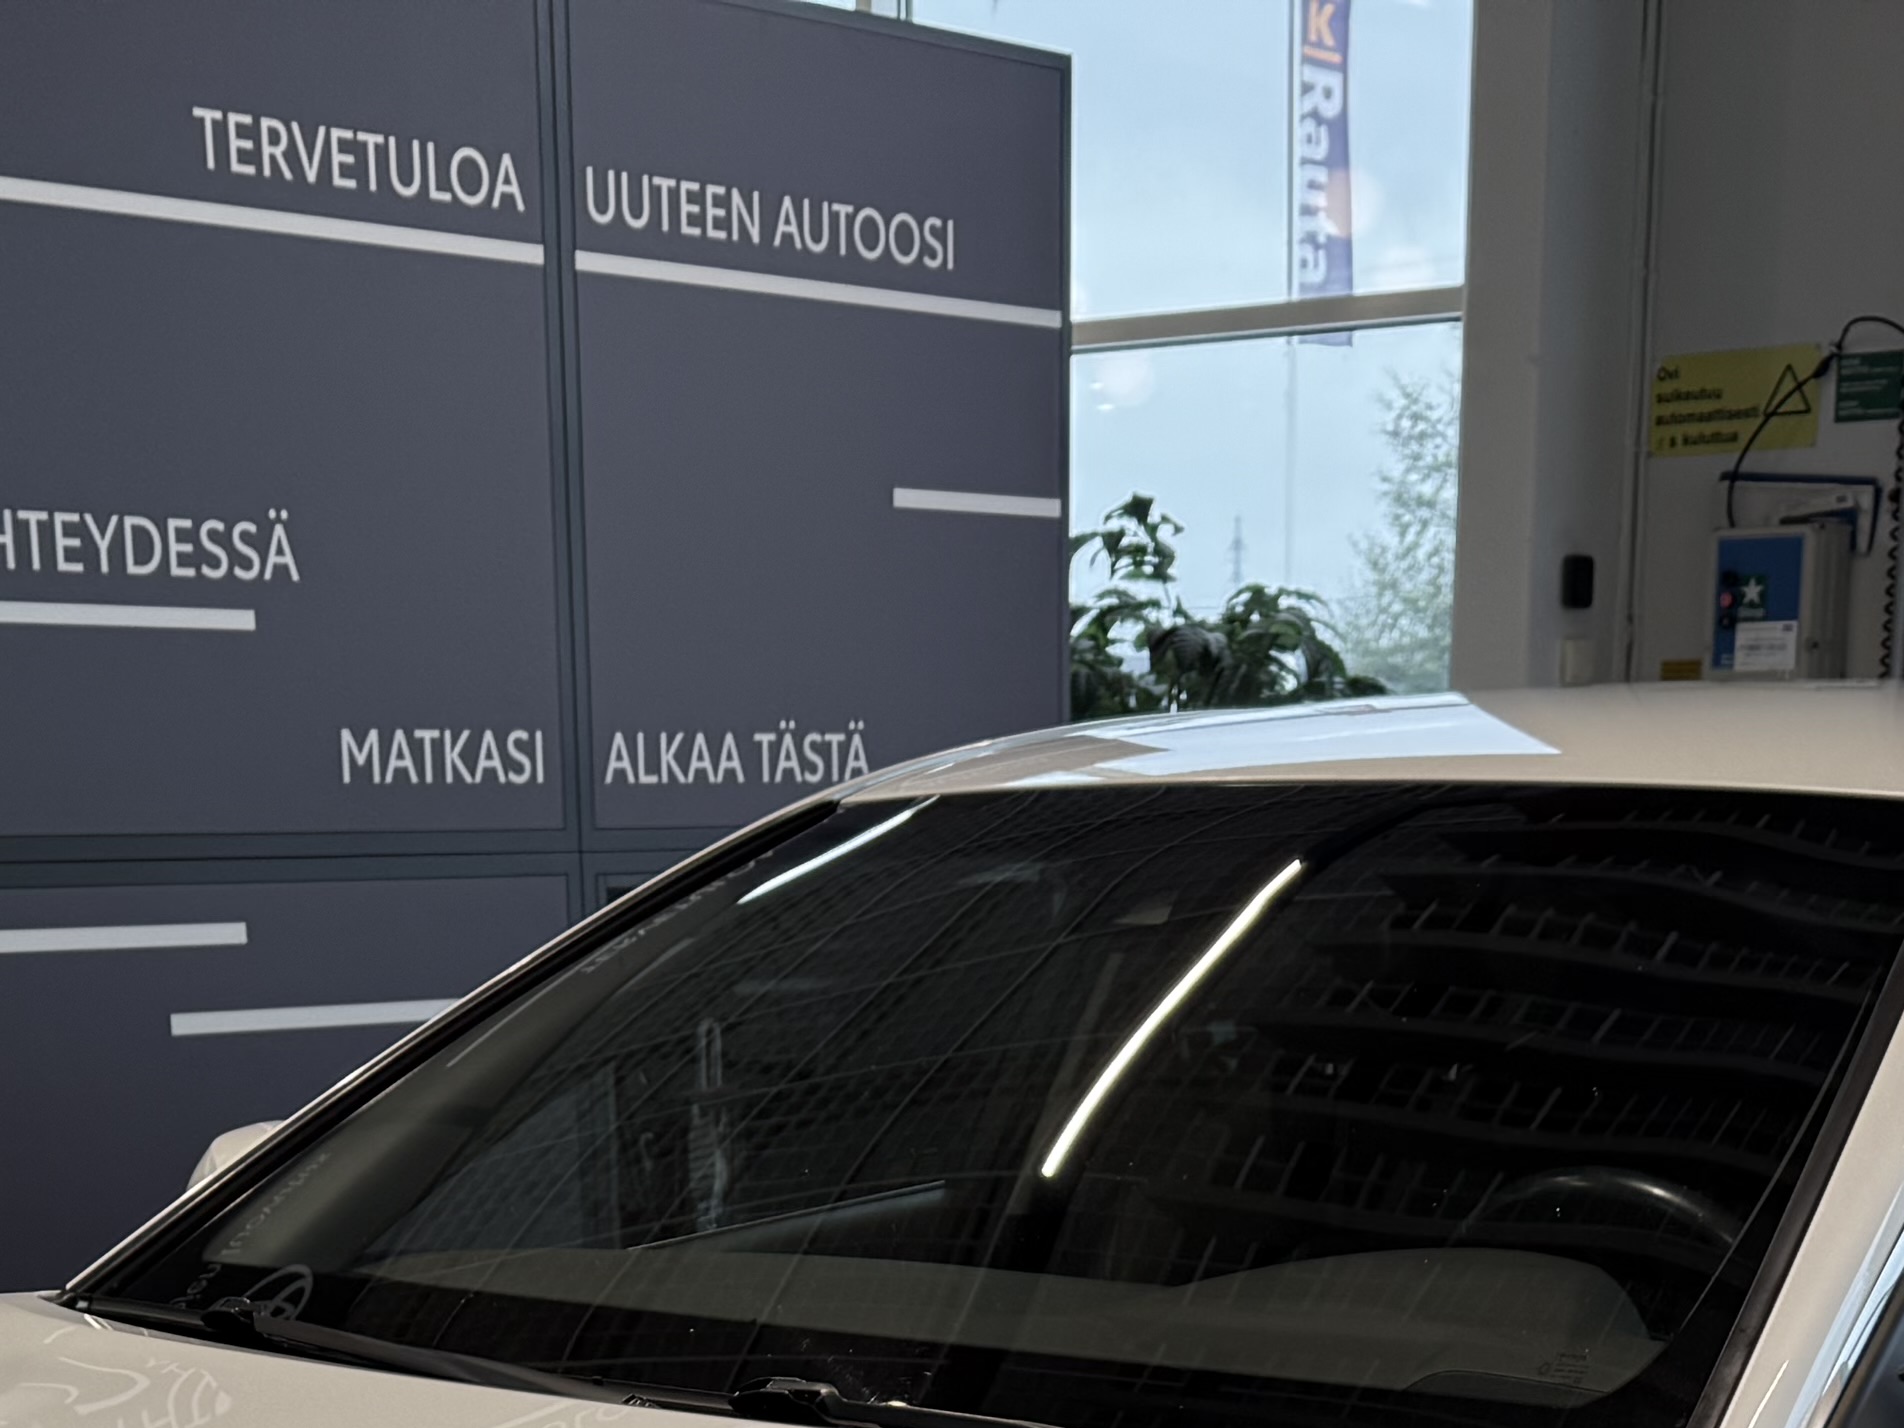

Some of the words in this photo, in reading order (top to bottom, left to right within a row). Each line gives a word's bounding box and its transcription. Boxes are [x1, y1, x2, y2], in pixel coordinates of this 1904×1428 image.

[192, 106, 526, 212] TERVETULOA
[586, 166, 761, 244] UUTEEN
[773, 195, 954, 271] AUTOOSI
[1300, 62, 1344, 285] Rauta
[340, 727, 545, 785] MATKASI
[604, 731, 745, 785] ALKAA
[753, 719, 870, 783] TÄSTÄ
